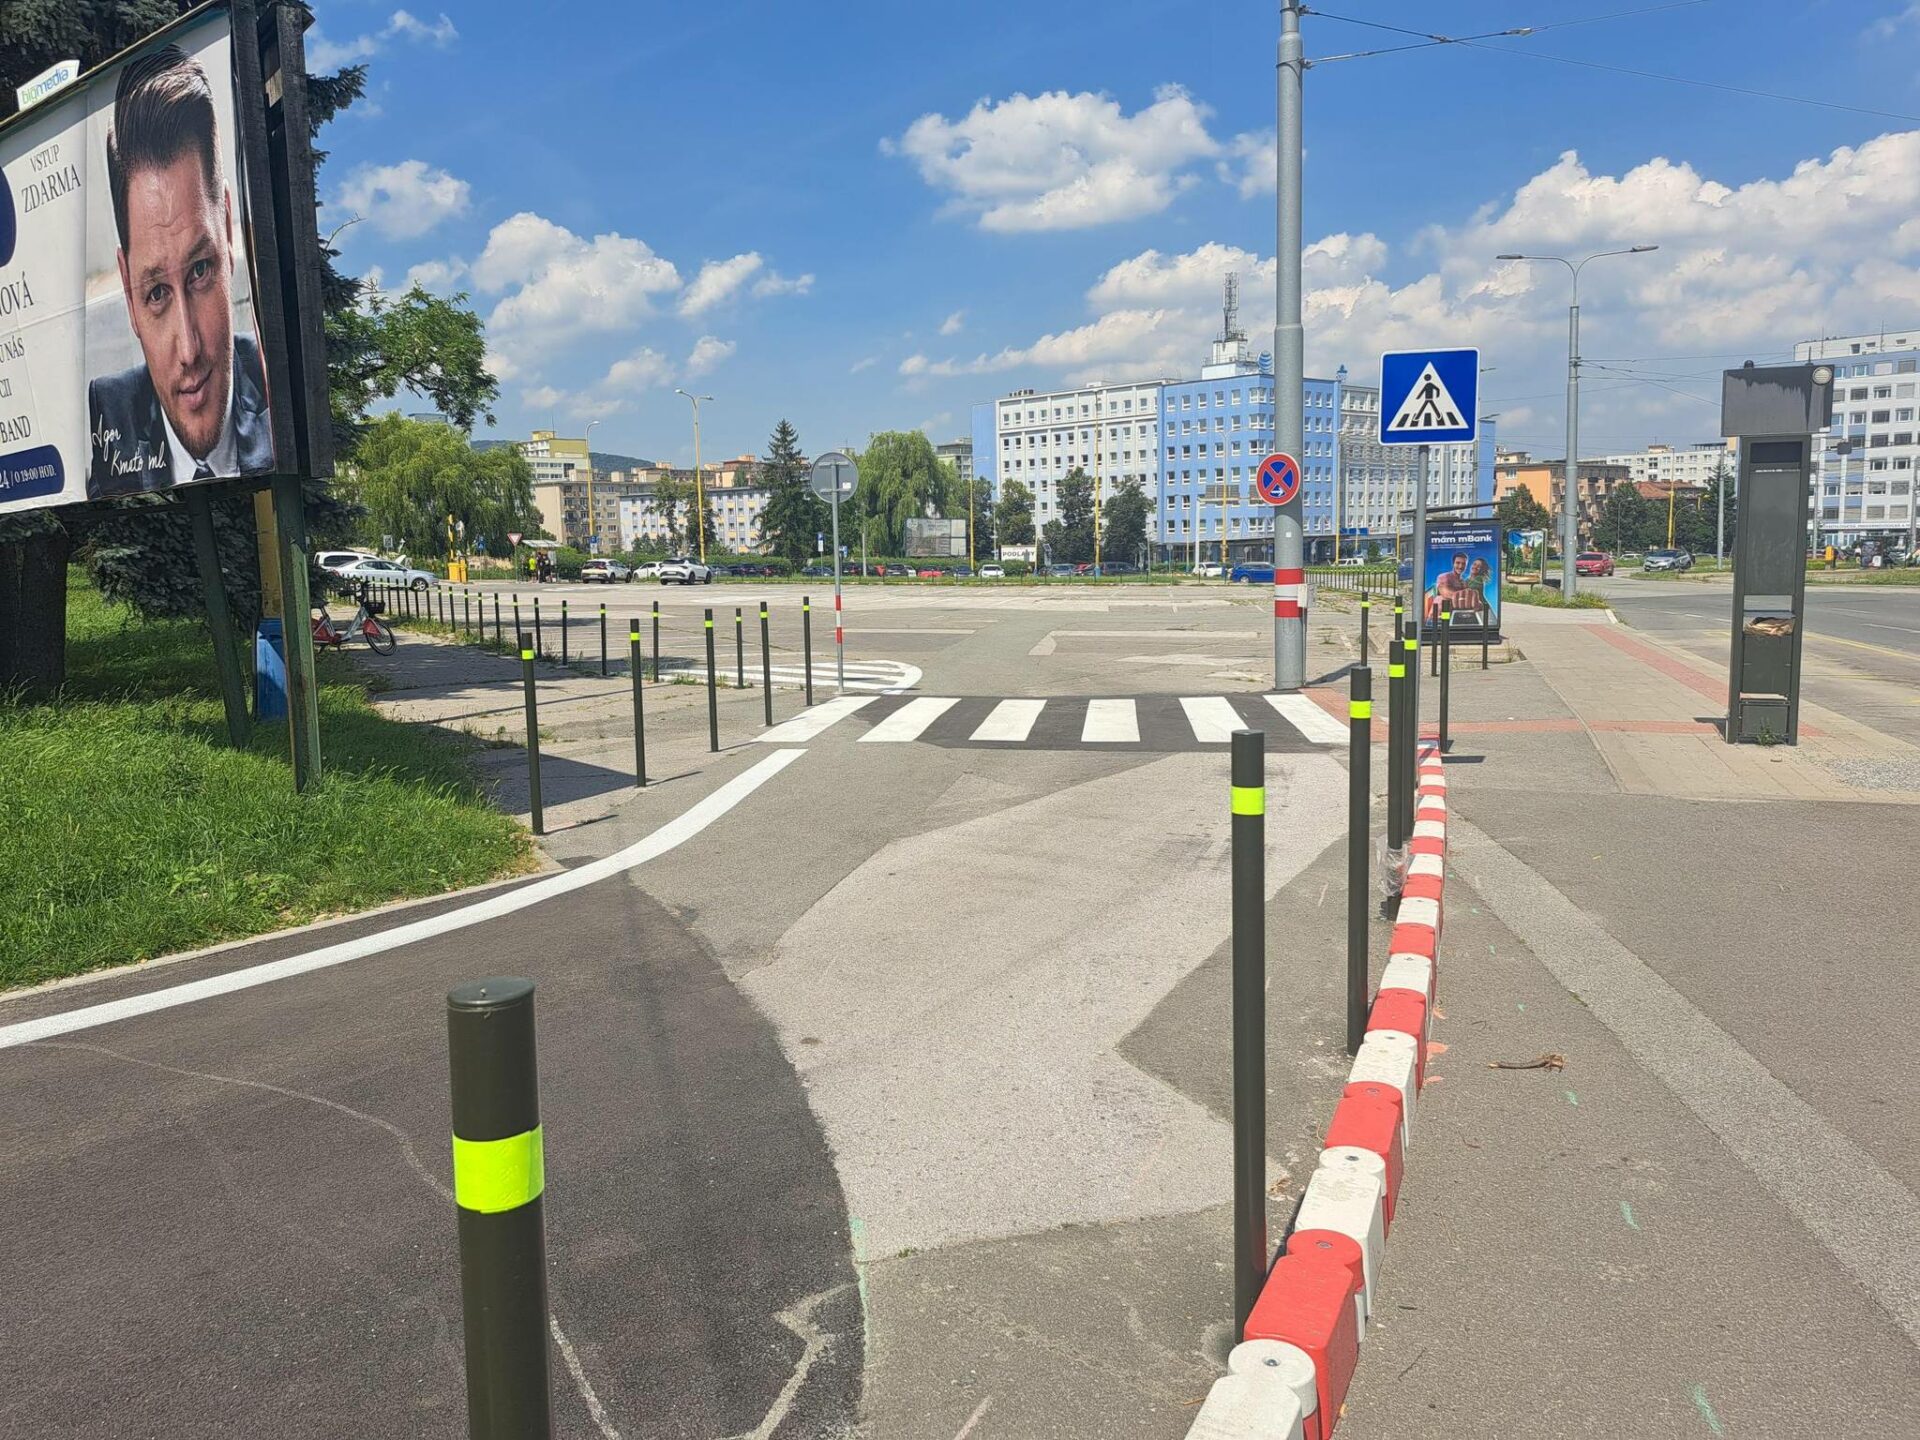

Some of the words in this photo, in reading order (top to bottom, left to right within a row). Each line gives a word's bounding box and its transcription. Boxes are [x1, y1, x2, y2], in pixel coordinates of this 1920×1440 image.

[21, 68, 69, 104] bigmedia
[30, 143, 60, 173] VSTUP
[21, 163, 82, 213] ZDARMA
[0, 271, 34, 317] OVÁ
[4, 334, 25, 361] NÁS
[0, 415, 31, 443] BAND
[92, 413, 121, 462] Igor
[20, 467, 39, 482] 19:00
[39, 464, 57, 479] HOD.
[1431, 535, 1456, 543] mám
[1458, 534, 1493, 543] mBank
